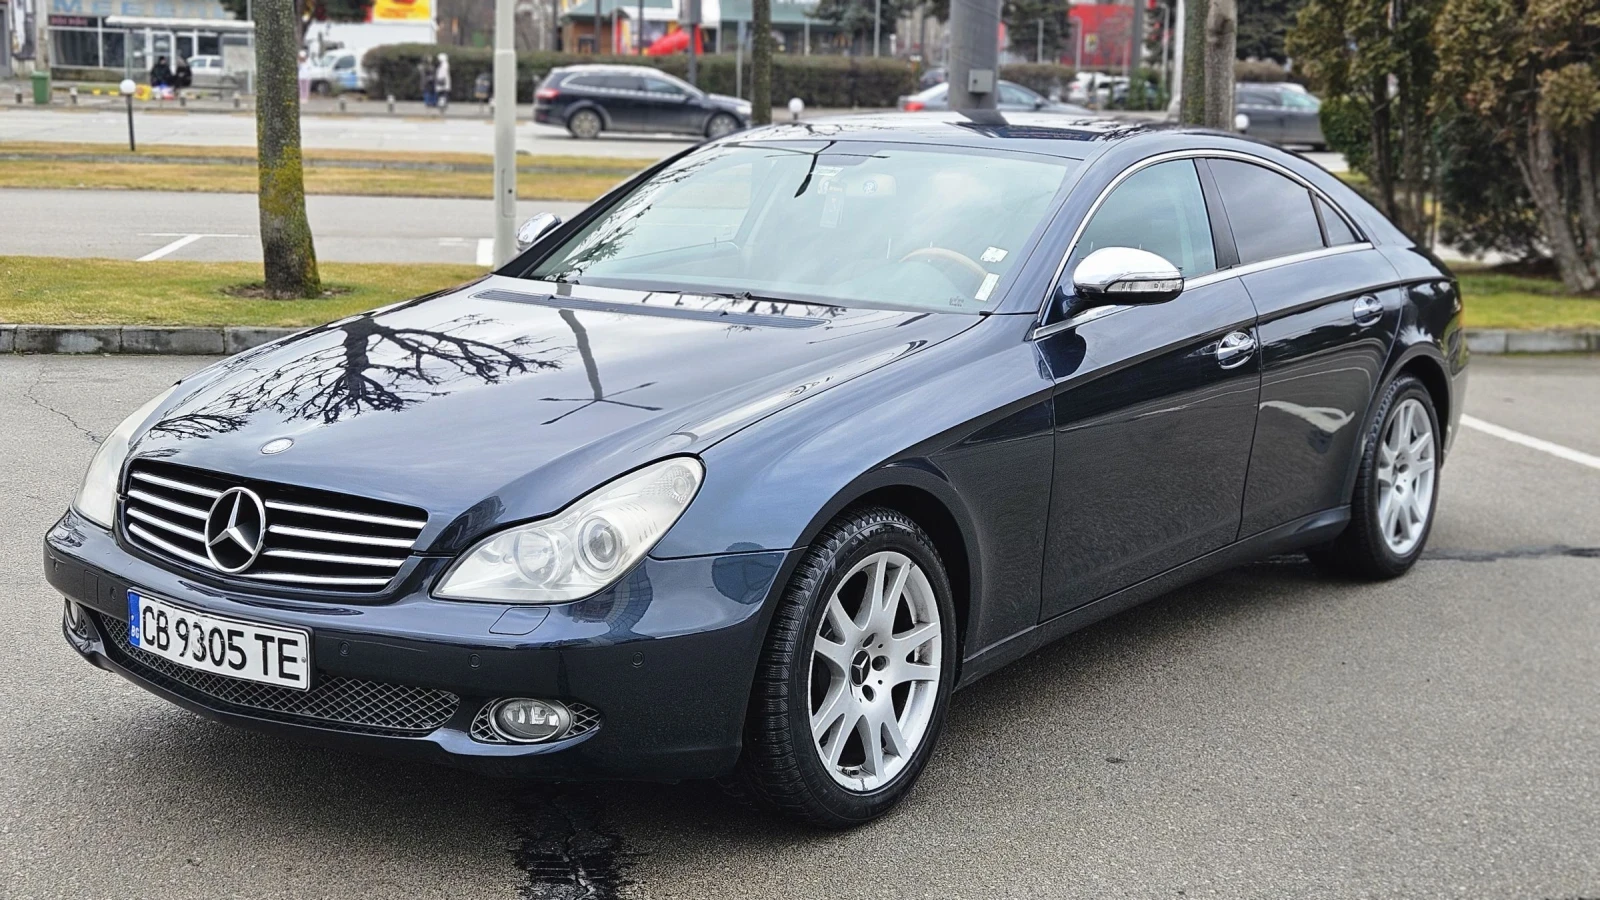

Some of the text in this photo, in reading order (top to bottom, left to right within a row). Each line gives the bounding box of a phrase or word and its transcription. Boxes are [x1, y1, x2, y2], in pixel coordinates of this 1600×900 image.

[131, 625, 140, 639] BG
[142, 606, 300, 681] CB 9305 TE
